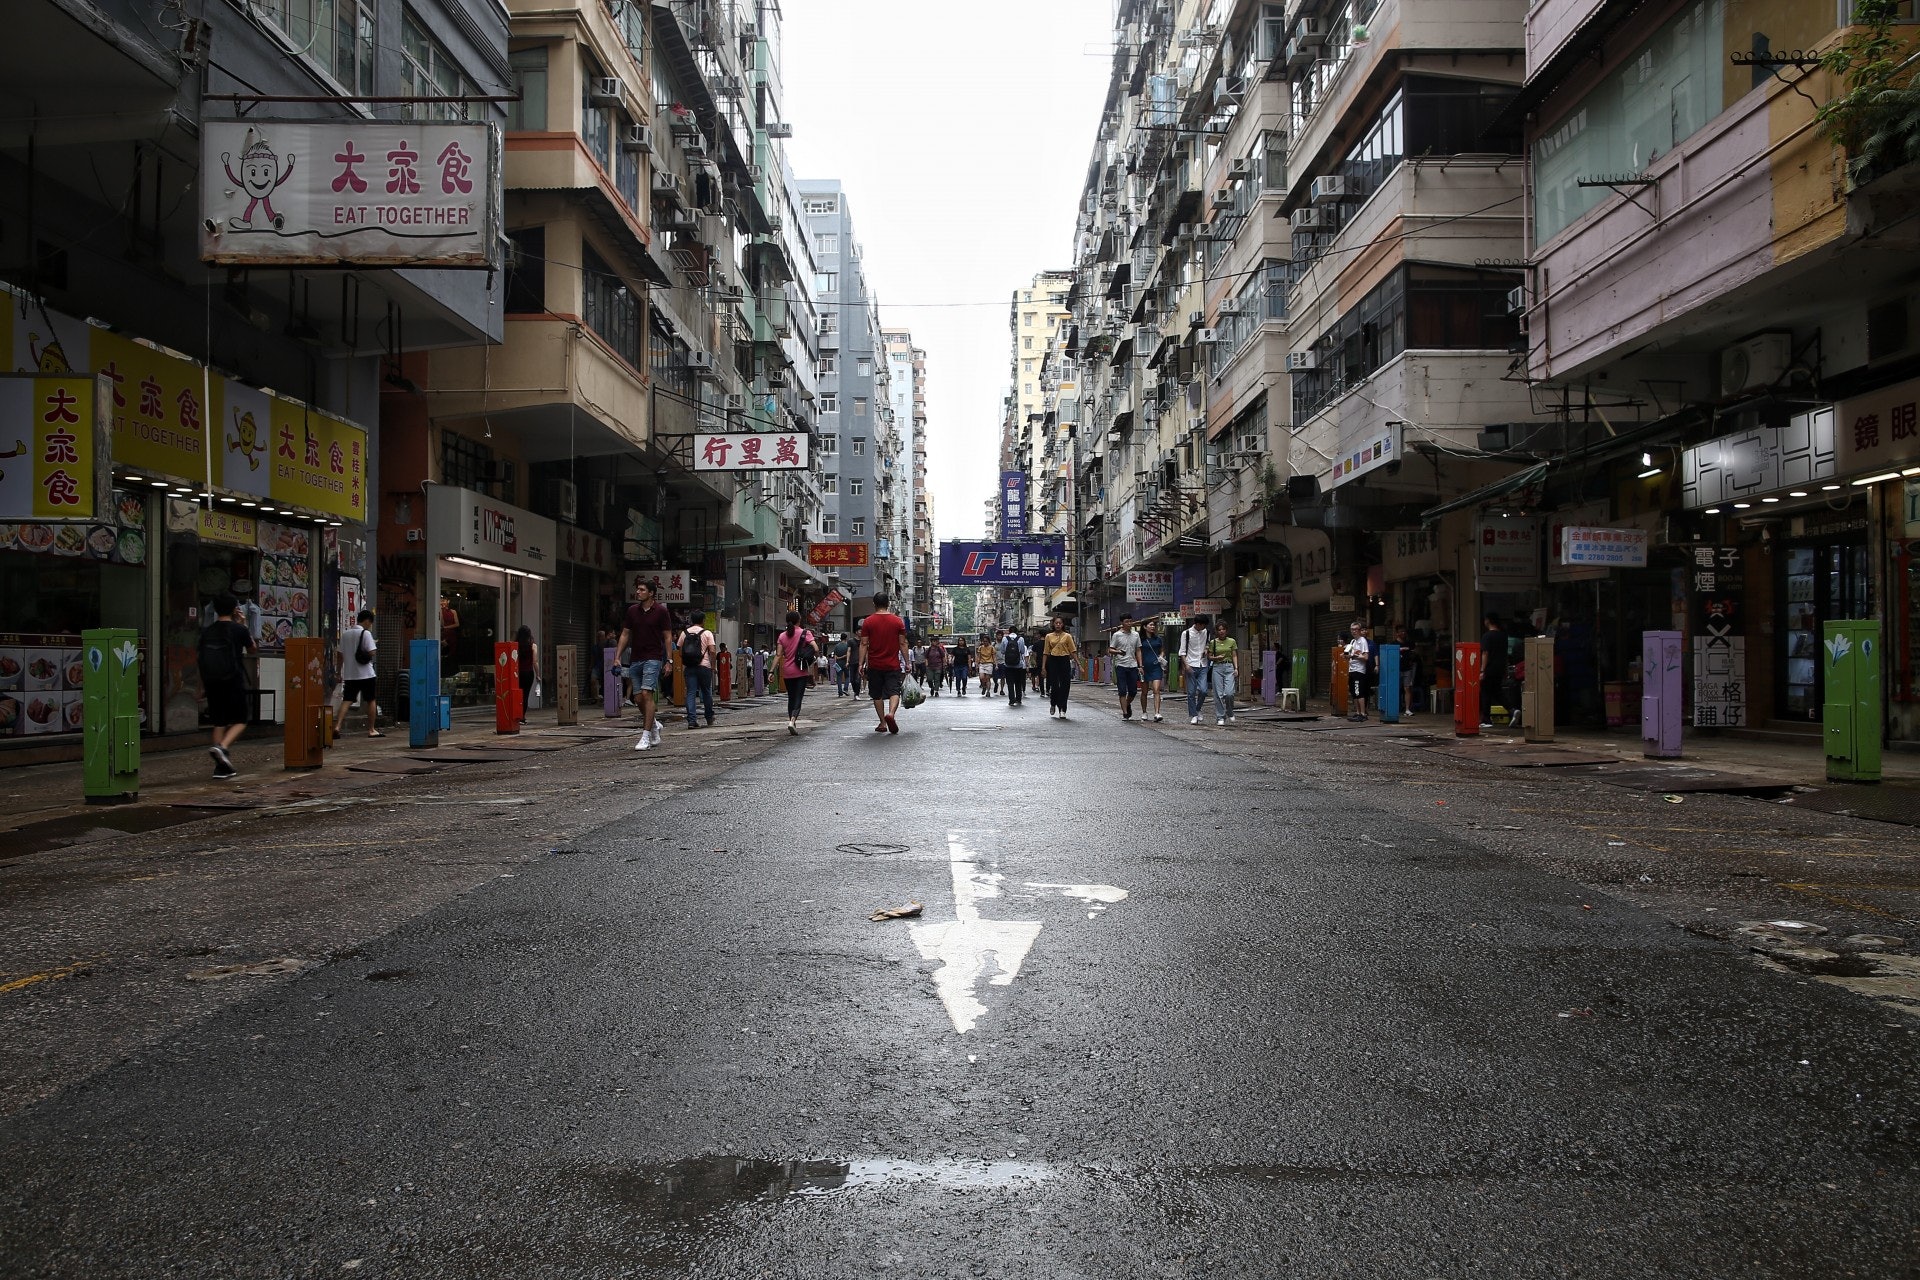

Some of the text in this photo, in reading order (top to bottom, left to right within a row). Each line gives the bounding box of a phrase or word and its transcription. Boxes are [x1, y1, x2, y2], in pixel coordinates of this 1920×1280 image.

[334, 206, 470, 225] EAT TOGETHER
[133, 420, 201, 454] TOGETHER
[278, 464, 344, 494] EAT TOGETHER
[812, 547, 849, 562] 恭和堂
[1001, 552, 1040, 570] 龍豐
[665, 592, 685, 601] HONG
